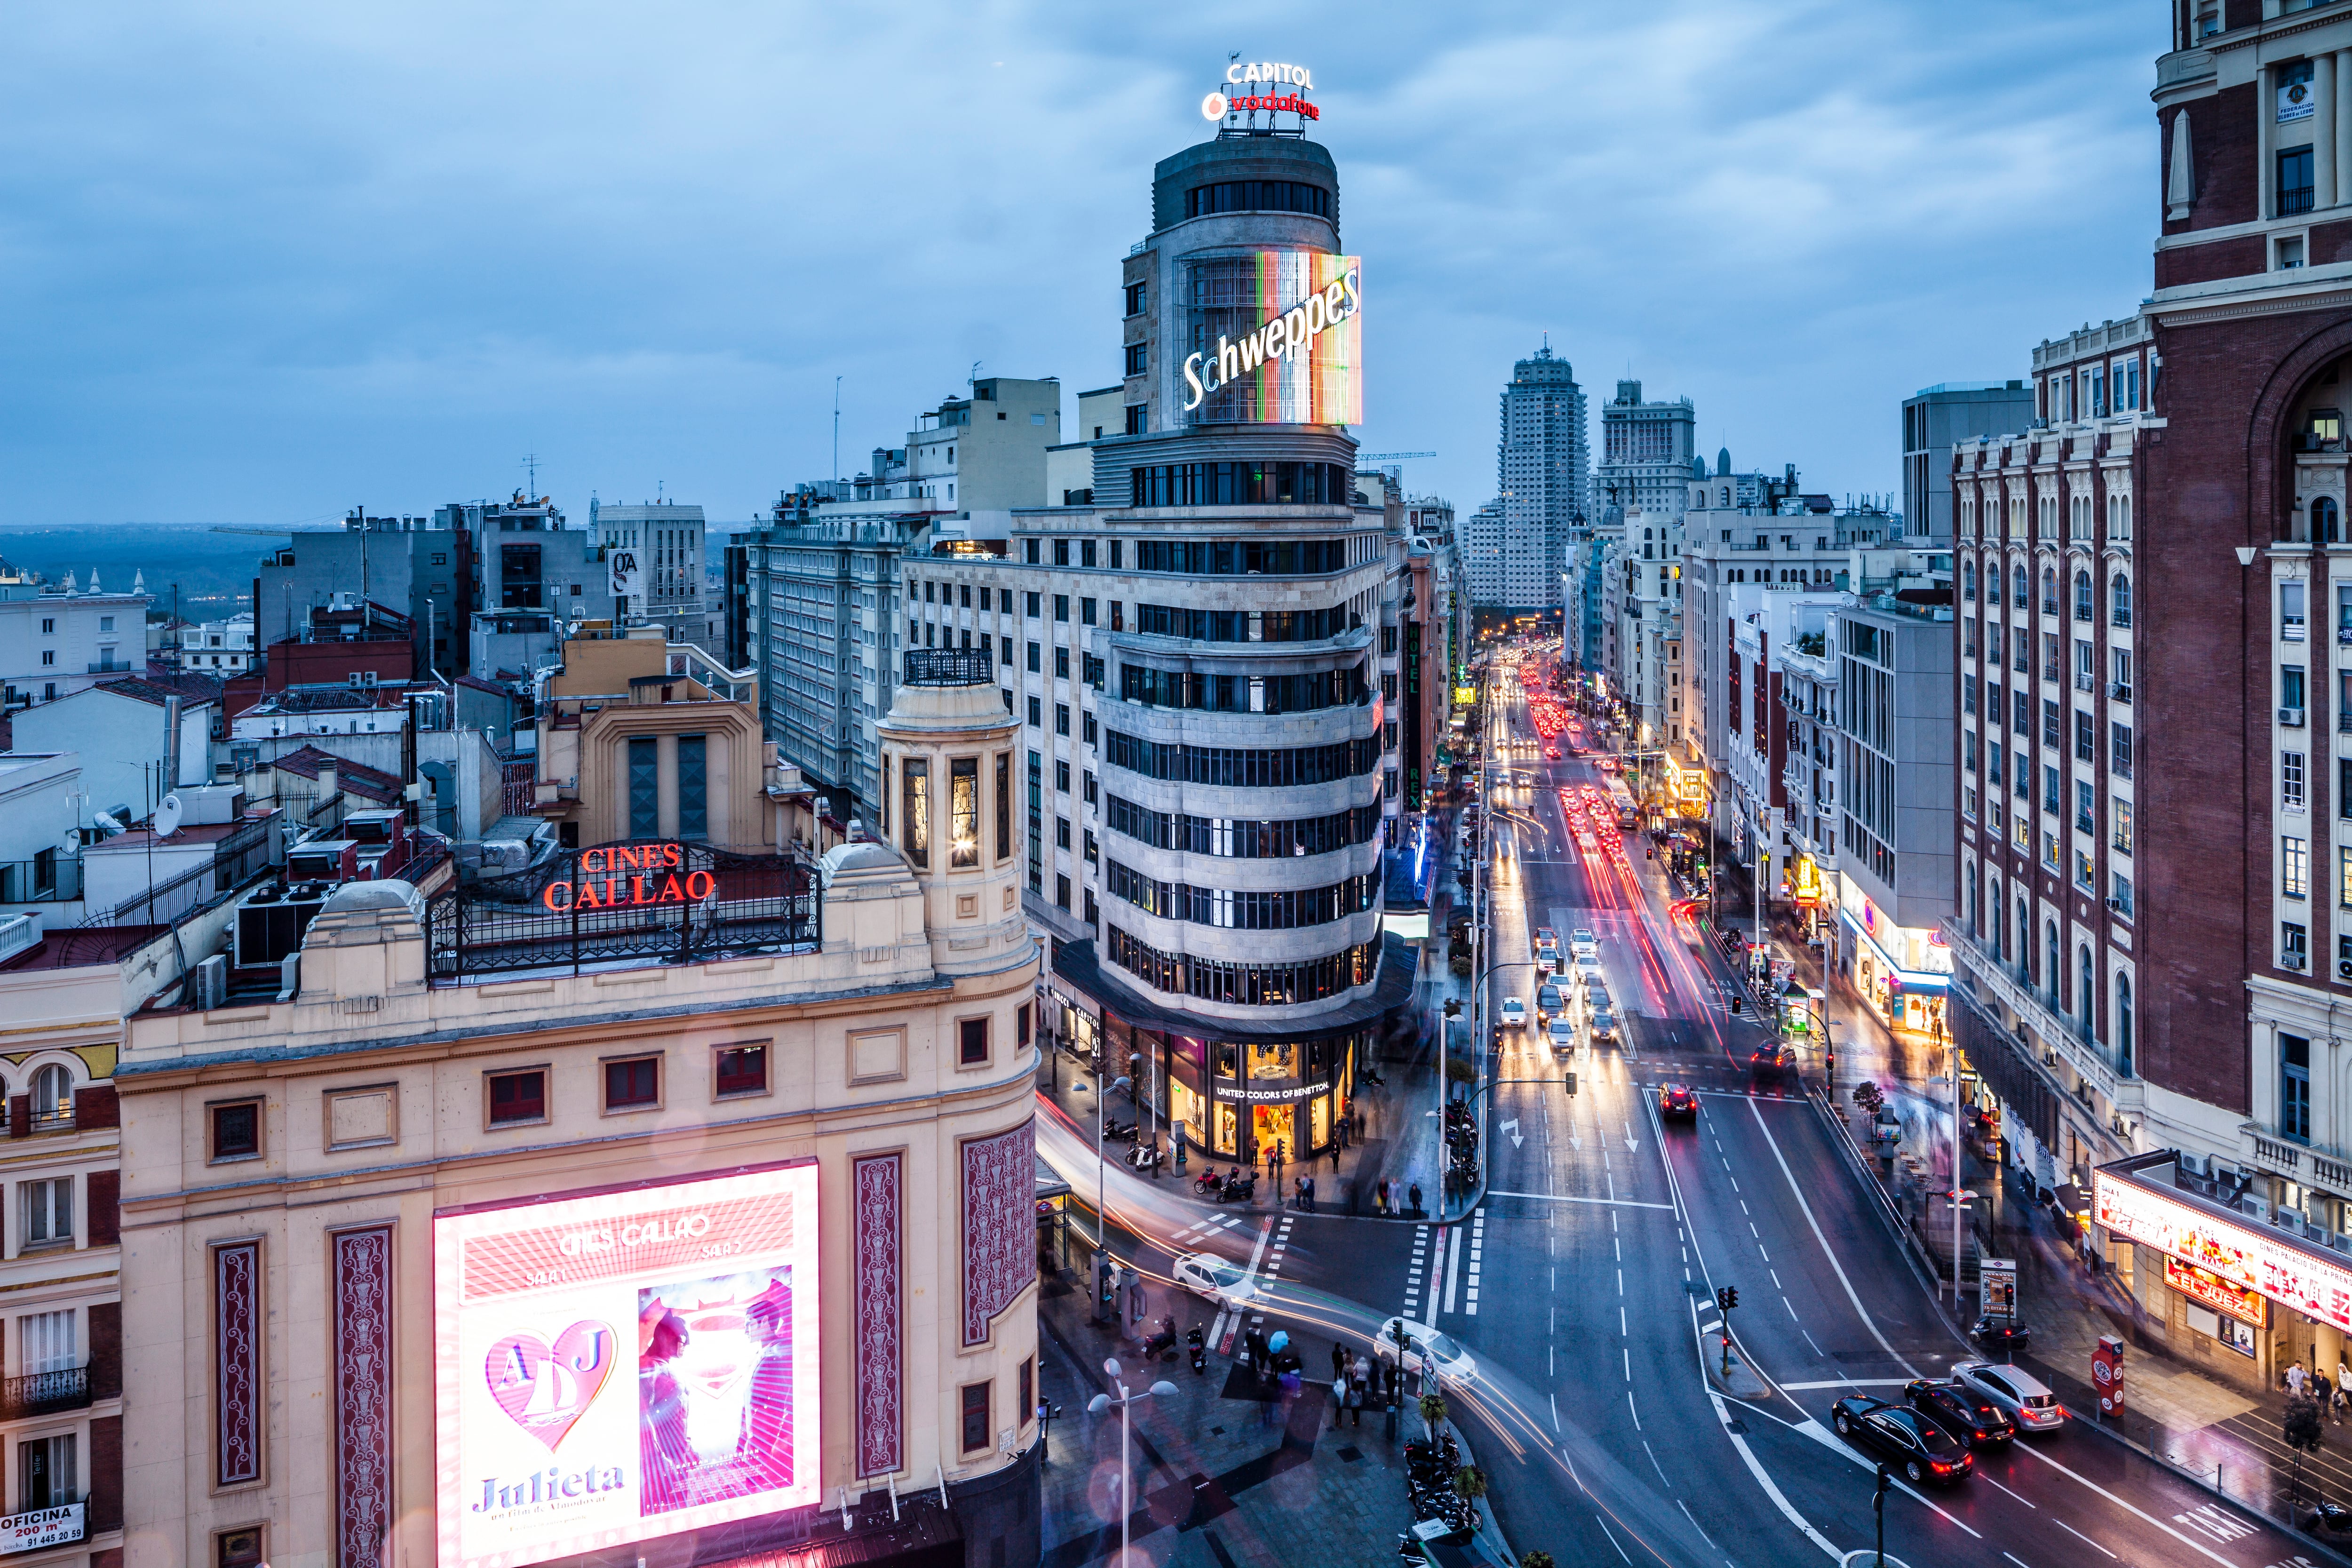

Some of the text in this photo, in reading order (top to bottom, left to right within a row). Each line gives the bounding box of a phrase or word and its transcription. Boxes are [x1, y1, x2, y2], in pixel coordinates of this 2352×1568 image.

[1227, 62, 1313, 90] CAPITOL
[1231, 89, 1320, 121] vodafone
[1184, 268, 1359, 411] Schweppes
[1409, 627, 1420, 807] HOTEL REX
[581, 843, 679, 873] CINES
[544, 871, 715, 911] CALLAO
[1700, 978, 1732, 987] TAXI
[1708, 987, 1735, 996] BUS
[1076, 1007, 1100, 1030] CAPITOL
[1217, 1087, 1245, 1098] UNITED
[1247, 1091, 1280, 1099] COLORS
[1282, 1089, 1293, 1099] OF
[2101, 1185, 2114, 1195] SALA
[559, 1214, 710, 1256] CINES CALLAO
[701, 1242, 742, 1258] SALA 2
[2260, 1242, 2279, 1256] CINES
[2281, 1252, 2307, 1267] PALACIO
[2310, 1263, 2318, 1272] DE
[2320, 1267, 2328, 1276] LA
[525, 1269, 566, 1287] SALA 1
[2180, 1275, 2200, 1293] EL
[2203, 1286, 2244, 1313] JUEZ
[496, 1327, 607, 1391] A J
[472, 1464, 625, 1513] Julieta
[1, 1507, 72, 1530] OFICINA
[15, 1525, 40, 1538] 200
[2171, 1503, 2261, 1544] TAXI
[27, 1528, 81, 1547] 91 445 20 59
